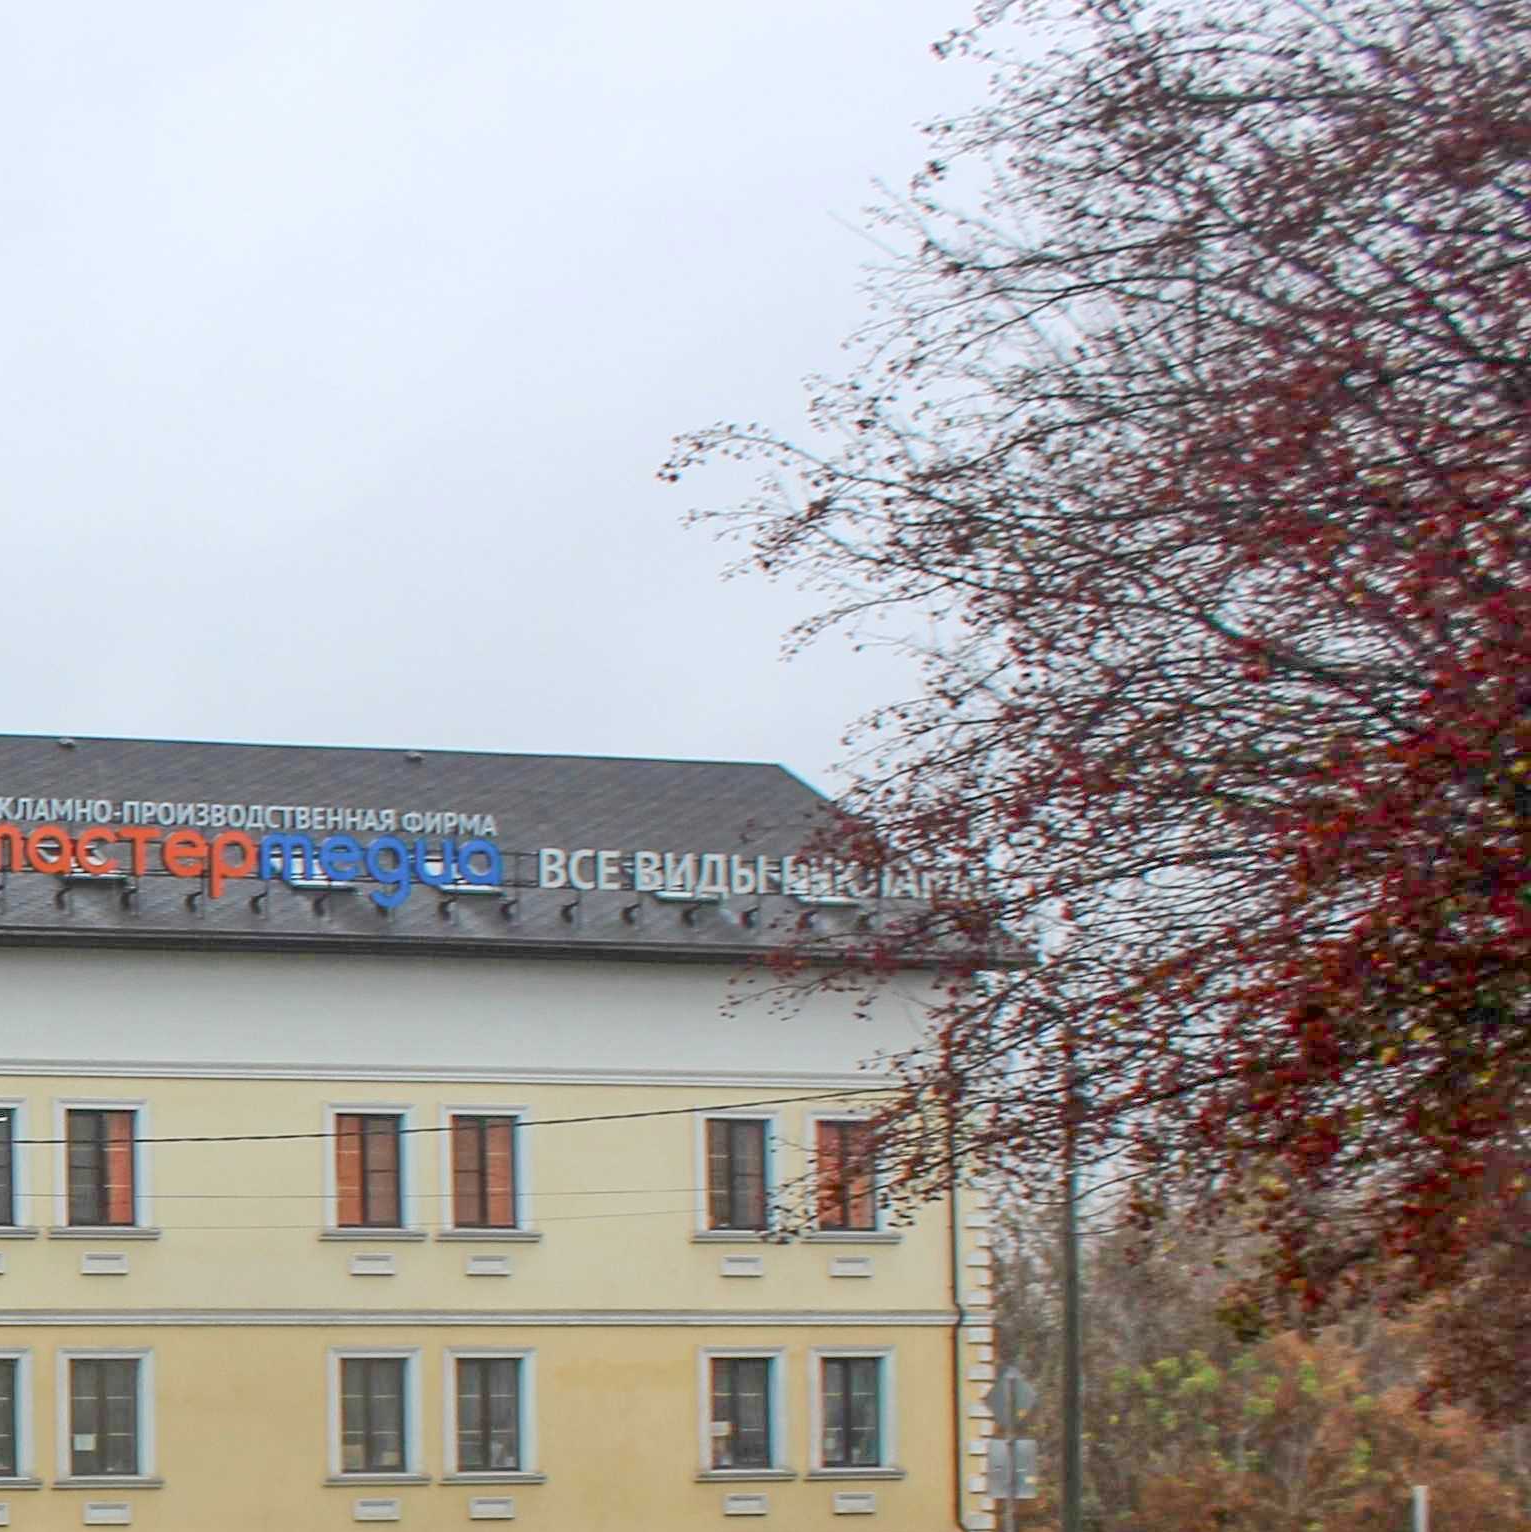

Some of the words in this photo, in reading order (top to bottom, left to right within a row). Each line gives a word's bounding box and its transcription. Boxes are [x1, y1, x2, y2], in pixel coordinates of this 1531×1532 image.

[401, 811, 498, 836] ФИРМА
[539, 848, 621, 890] ВСЕ
[634, 850, 769, 899] ВИДЫ
